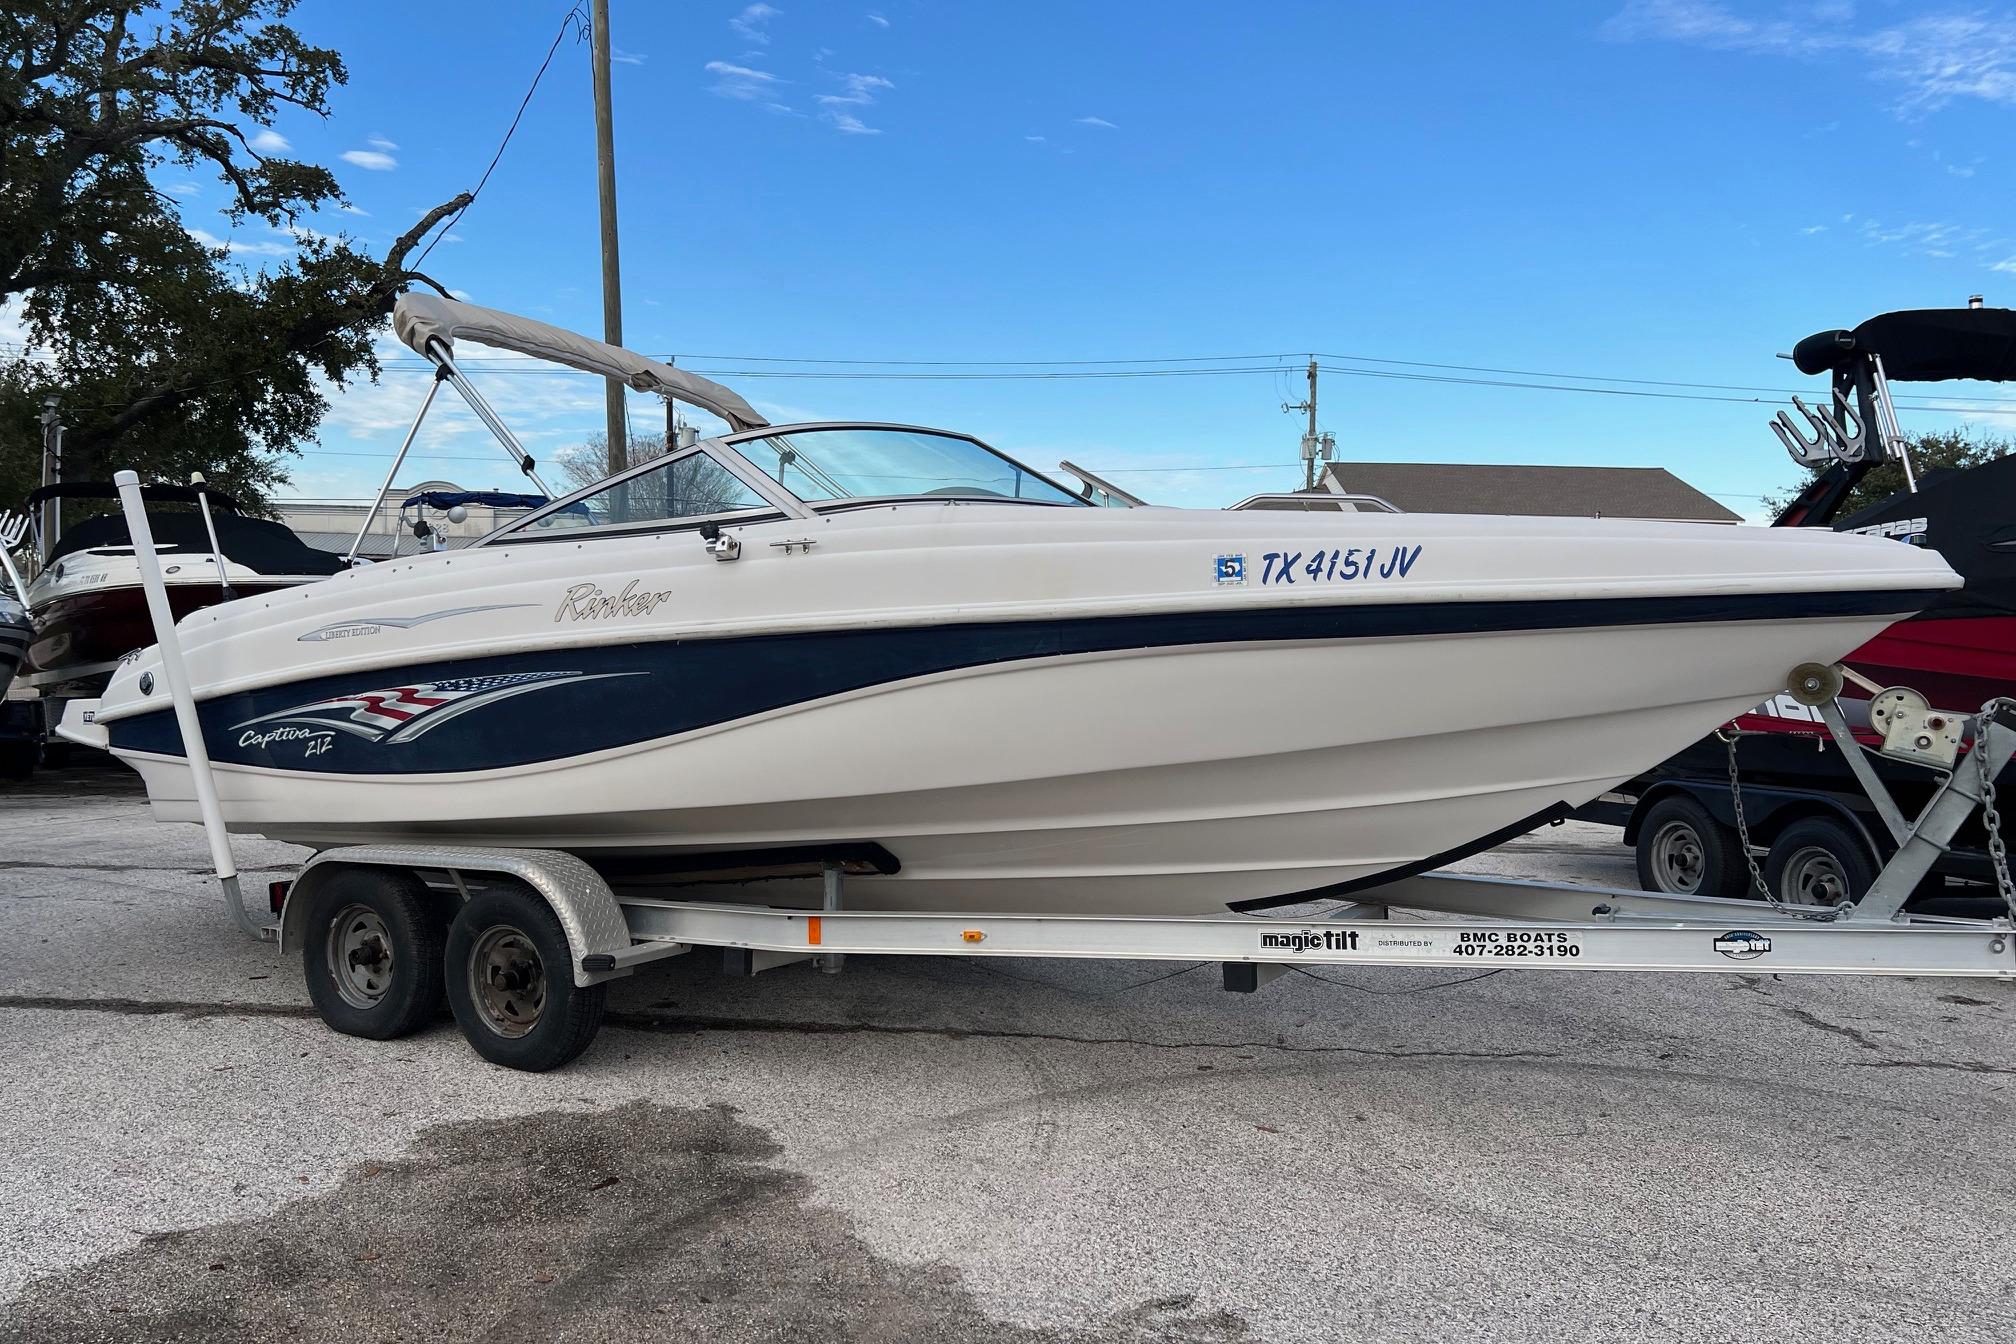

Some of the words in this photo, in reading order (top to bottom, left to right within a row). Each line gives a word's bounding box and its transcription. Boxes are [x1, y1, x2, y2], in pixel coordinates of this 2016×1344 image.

[1224, 559, 1236, 577] 5
[1262, 551, 1302, 586] TX
[1305, 548, 1377, 582] 4151
[1379, 544, 1423, 579] JV
[554, 579, 672, 622] Rinker
[325, 629, 351, 640] LIBERTY
[351, 625, 381, 638] EDITION
[238, 726, 337, 750] Captiva
[304, 736, 333, 758] 212
[1378, 940, 1422, 948] DISTRIBUTED
[1423, 940, 1433, 948] BY
[1460, 932, 1500, 943] BMC
[1506, 932, 1568, 943] BOATS
[1452, 944, 1581, 957] 407-282-3190
